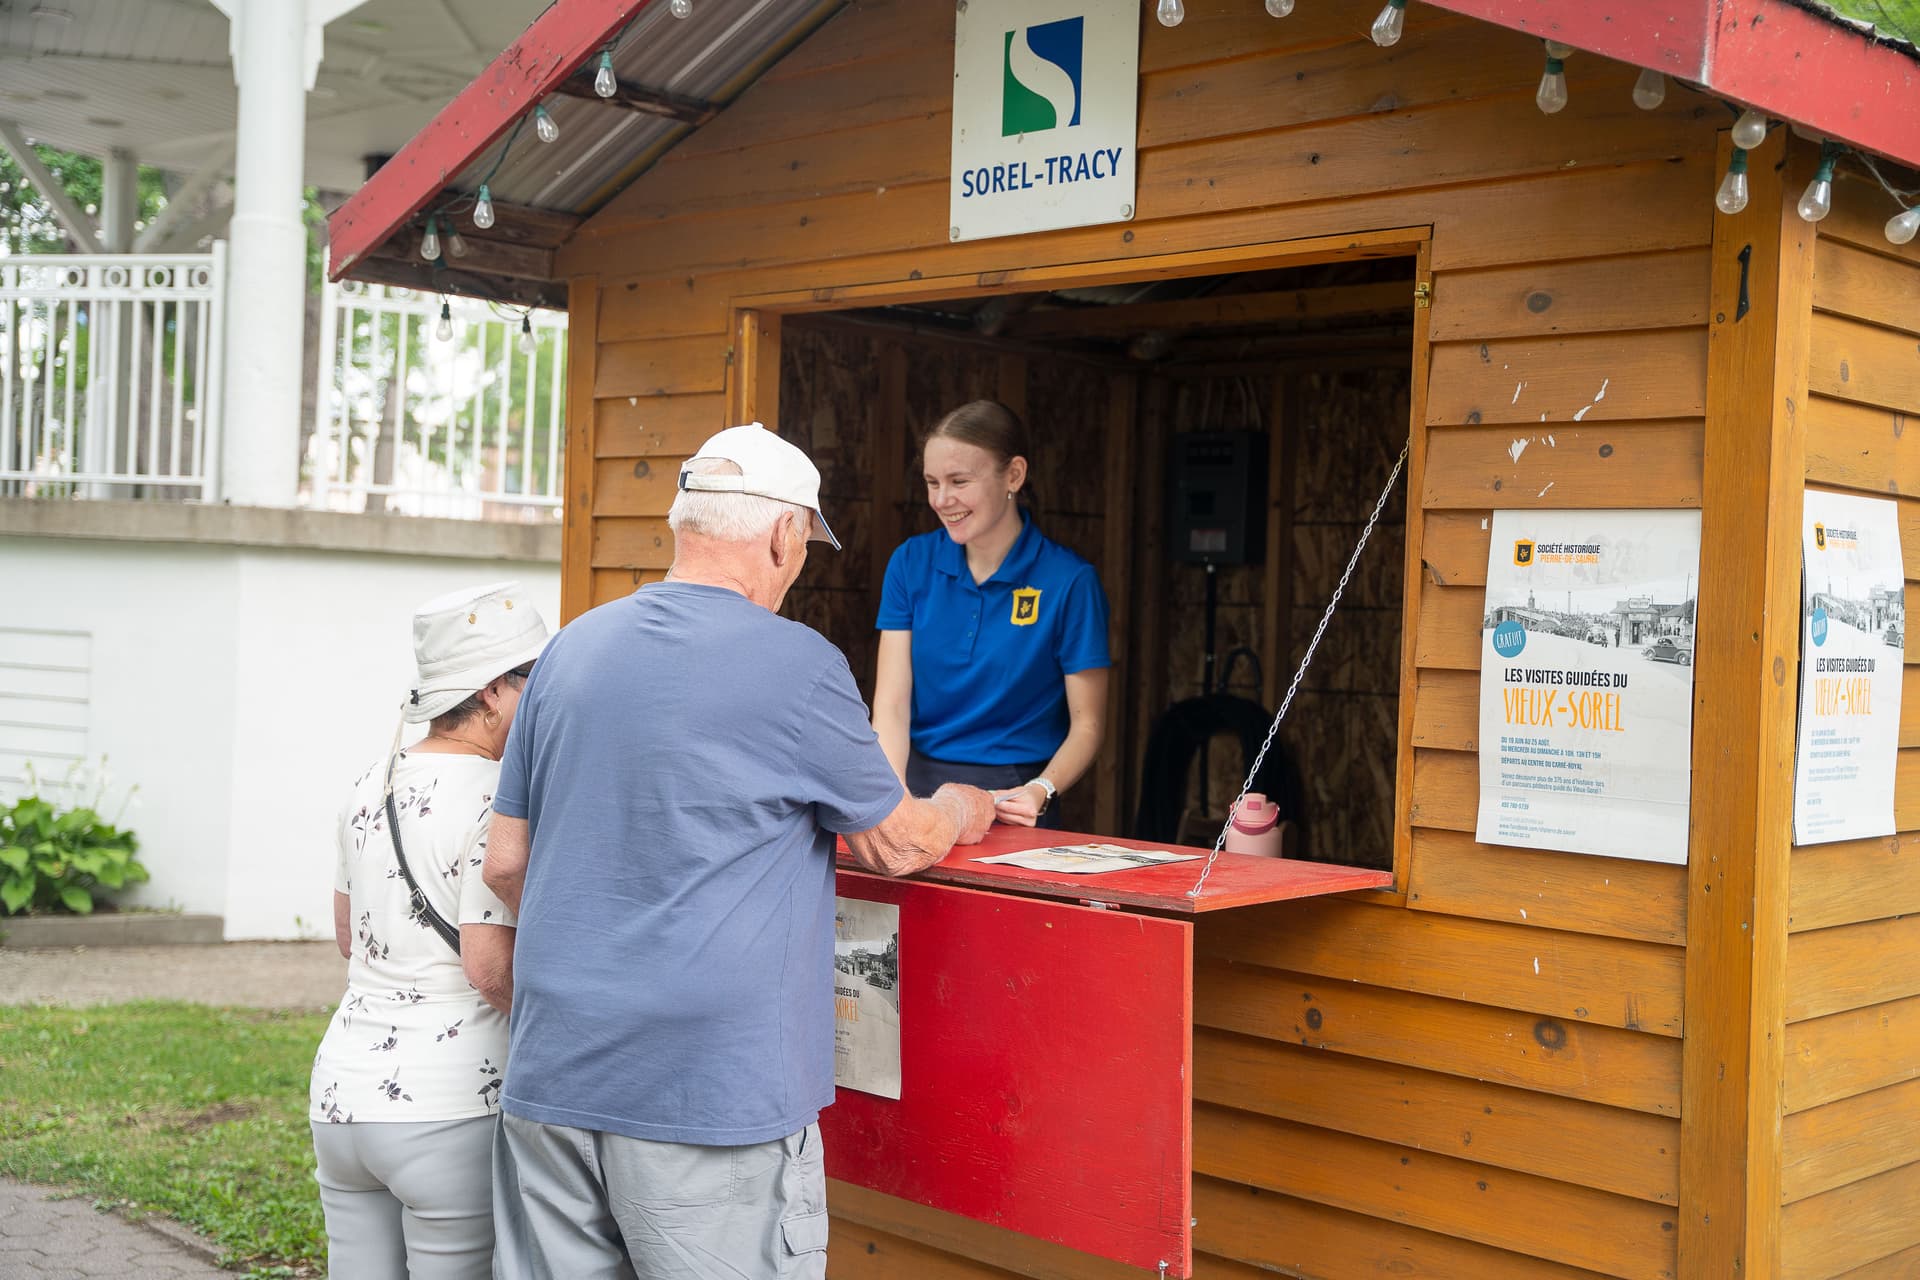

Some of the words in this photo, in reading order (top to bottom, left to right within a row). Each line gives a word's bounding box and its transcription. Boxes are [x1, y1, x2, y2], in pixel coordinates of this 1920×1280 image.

[962, 147, 1122, 197] SOREL-TRACY
[1537, 542, 1563, 554] SOCIÉTÉ
[1564, 544, 1600, 555] HISTORIQUE
[1816, 658, 1826, 672] LES
[1827, 658, 1845, 672] VISITES
[1846, 656, 1867, 672] GUIDÉES
[1868, 659, 1876, 672] DU
[1505, 668, 1522, 682] LES
[1526, 669, 1563, 685] VISITES
[1566, 669, 1610, 687] GUIDÉES
[1613, 673, 1628, 688] DU
[1503, 687, 1625, 731] VIEUX-SOREL
[1537, 748, 1560, 756] DIMANCHE
[1528, 759, 1545, 767] CENTRE
